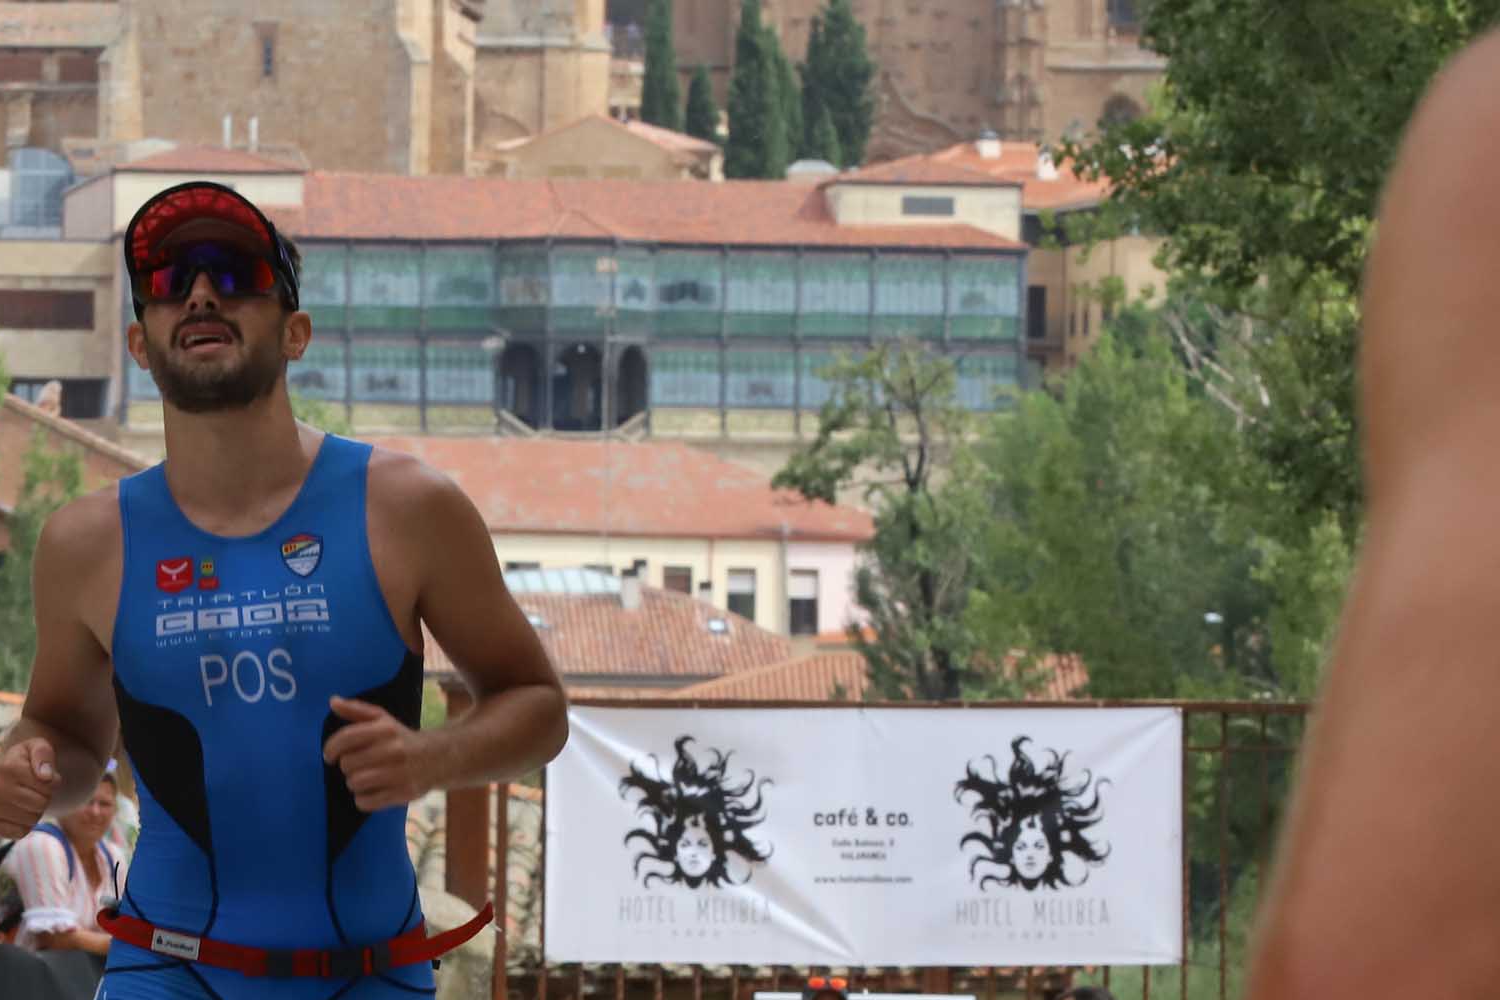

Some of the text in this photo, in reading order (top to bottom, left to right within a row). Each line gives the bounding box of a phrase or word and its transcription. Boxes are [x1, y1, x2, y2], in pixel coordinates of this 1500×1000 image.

[199, 647, 298, 707] POS
[865, 806, 878, 826] &
[618, 896, 677, 924] HOTEL
[955, 897, 1111, 927] HOTEL MELIBEA
